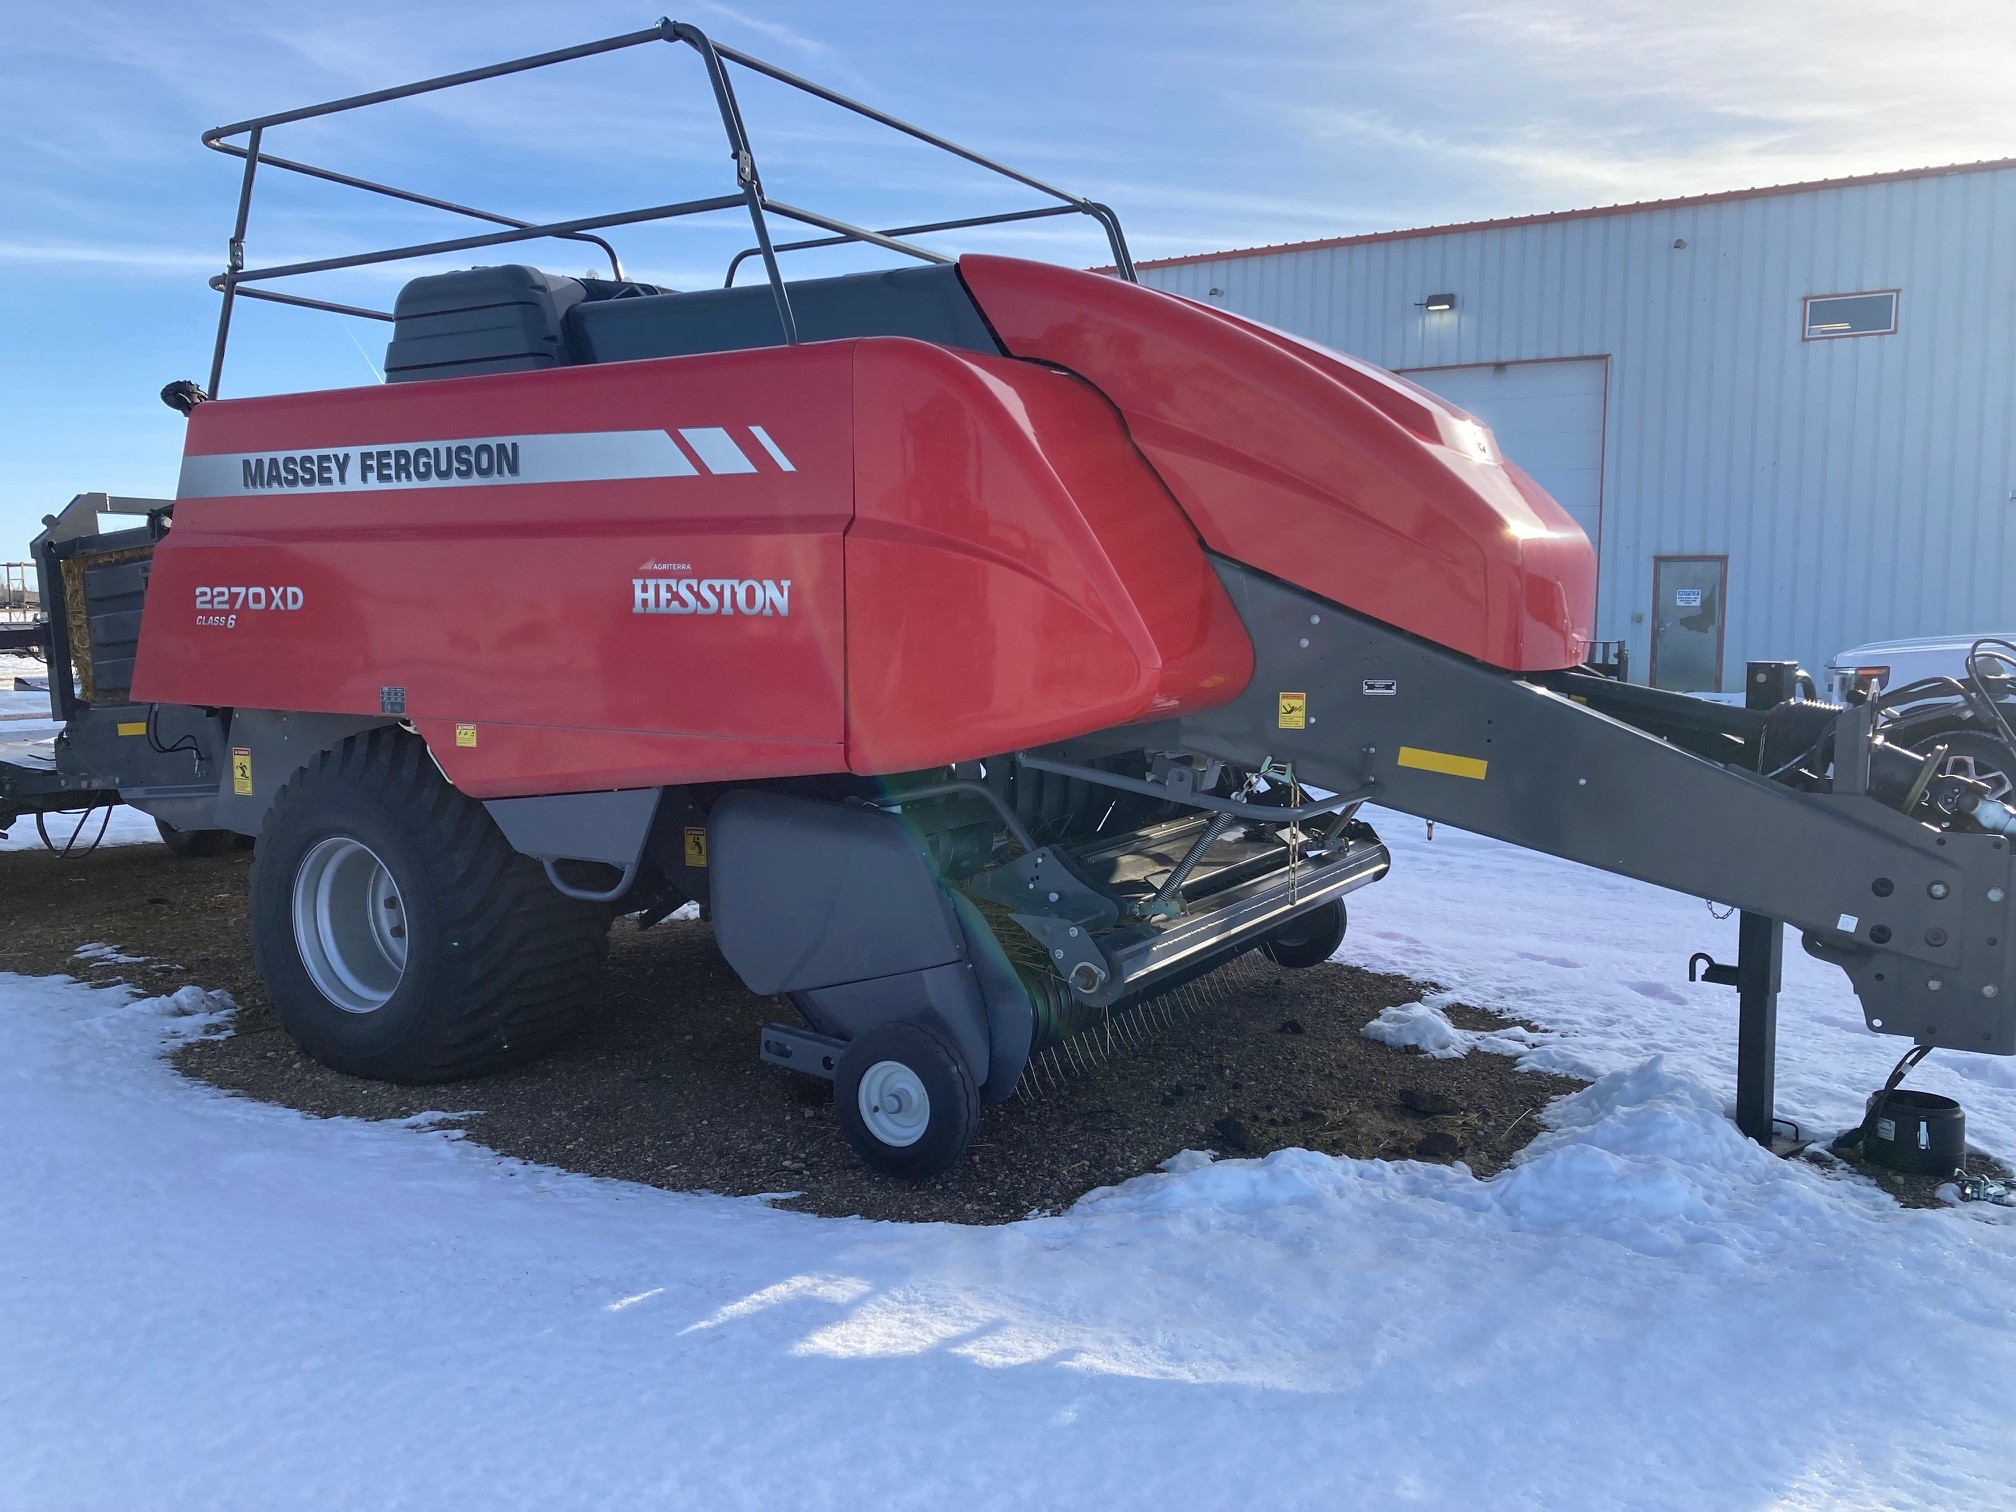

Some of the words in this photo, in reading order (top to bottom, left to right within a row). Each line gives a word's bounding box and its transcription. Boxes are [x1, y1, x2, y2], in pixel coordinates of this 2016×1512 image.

[242, 453, 351, 489] MASSEY
[360, 442, 520, 484] FERGUSON
[653, 563, 692, 571] AGRITERRA
[632, 578, 791, 616] HESSTON
[196, 616, 225, 626] CLASS
[227, 614, 236, 628] 6
